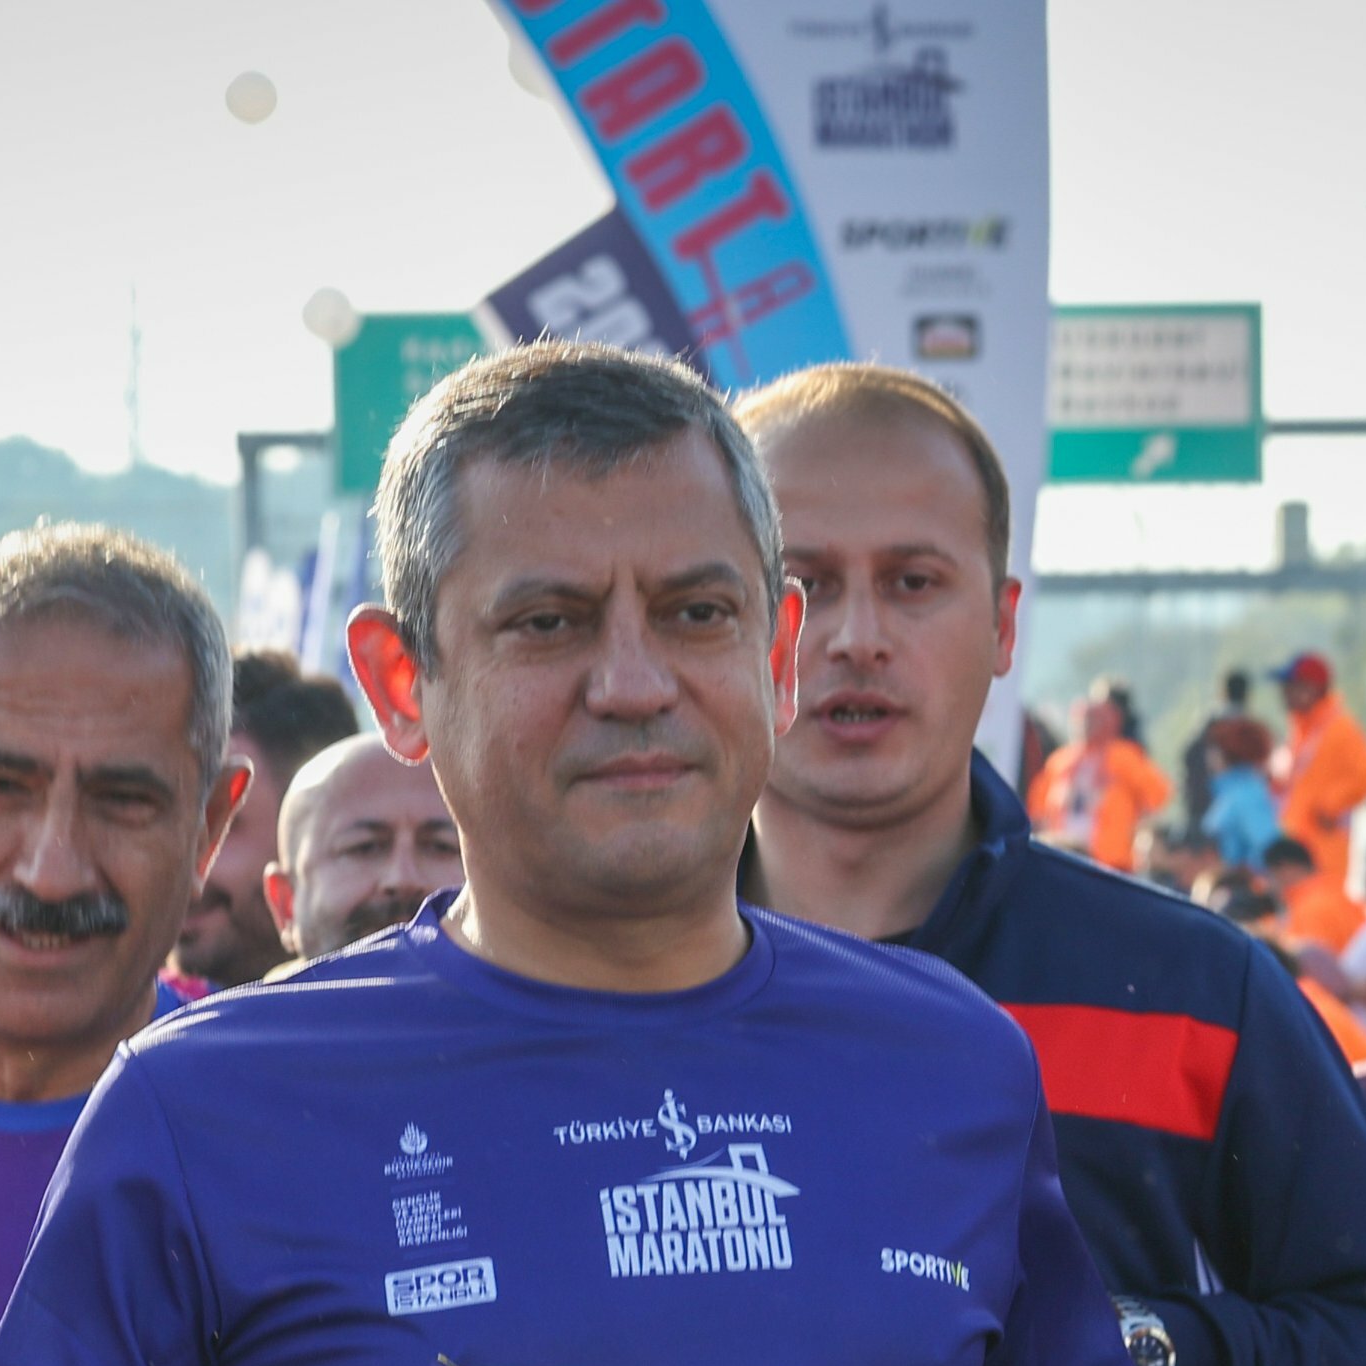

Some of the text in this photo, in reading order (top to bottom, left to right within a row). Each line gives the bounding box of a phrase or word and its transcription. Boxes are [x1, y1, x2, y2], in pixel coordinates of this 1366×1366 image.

[513, 0, 791, 264] TART
[553, 1116, 657, 1146] TÜRKİYE
[696, 1113, 792, 1134] BANKASI
[606, 1225, 793, 1278] MARATONU
[881, 1247, 970, 1292] SPORTIVE
